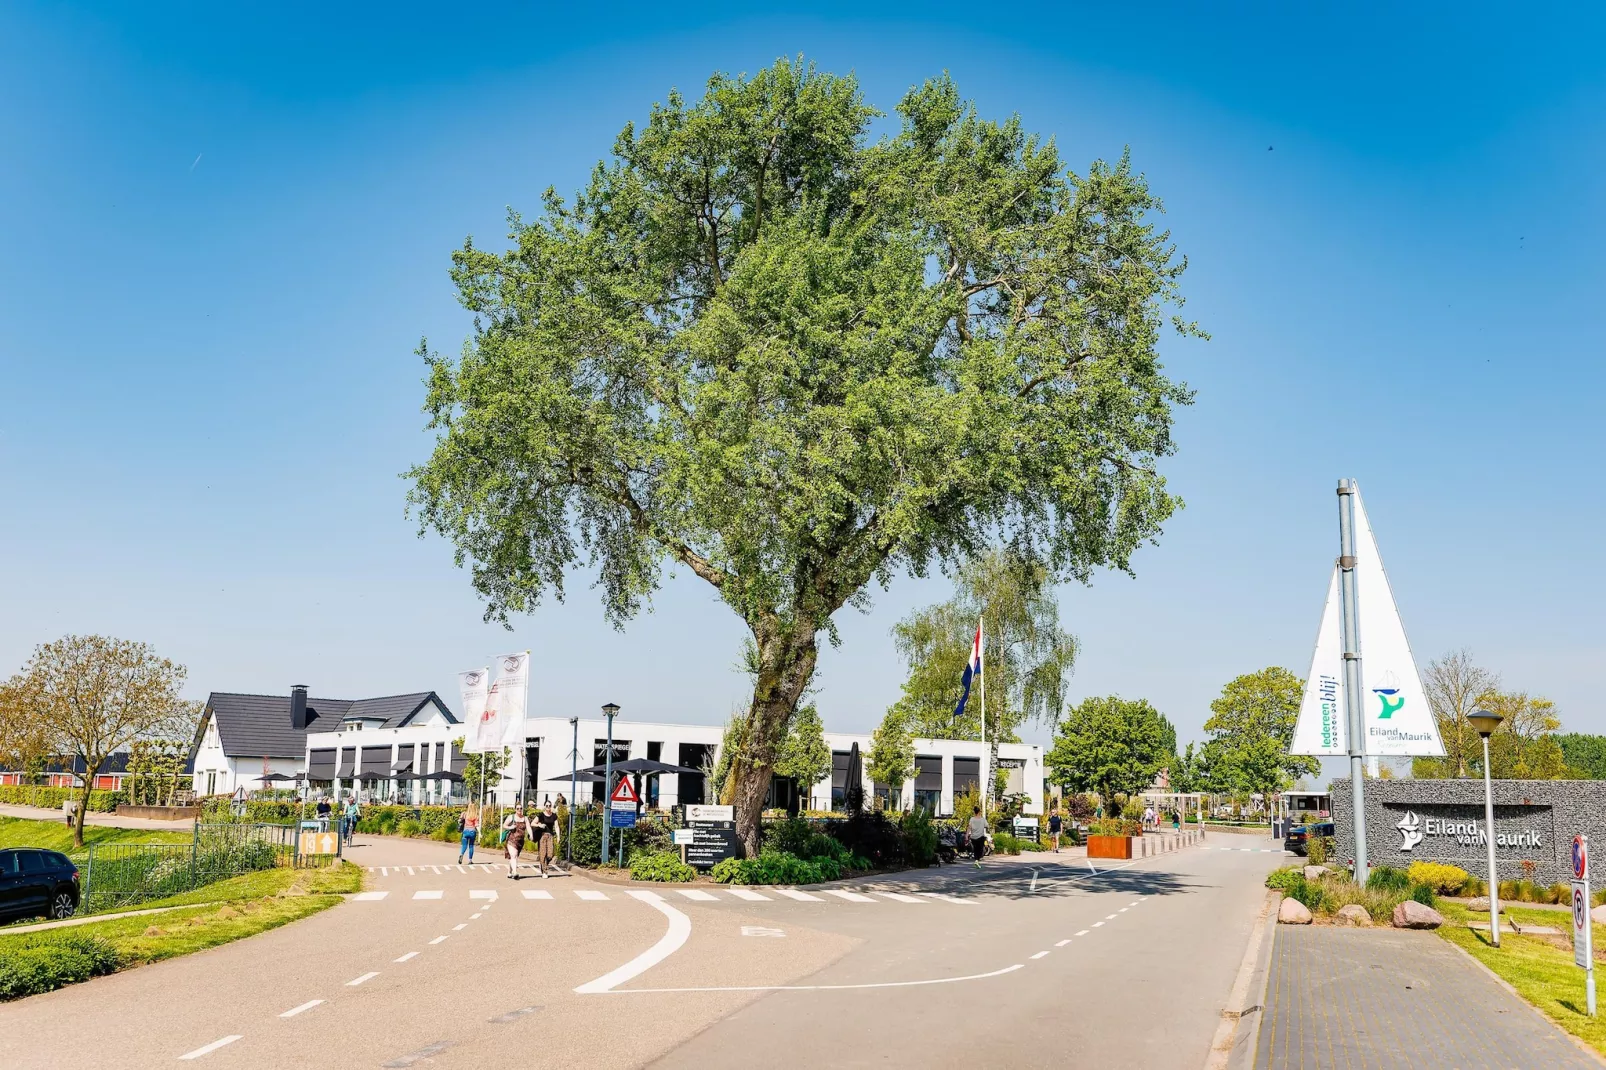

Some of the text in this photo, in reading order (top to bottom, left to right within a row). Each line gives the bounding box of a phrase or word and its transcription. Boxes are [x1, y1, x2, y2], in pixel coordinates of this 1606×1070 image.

[1319, 675, 1340, 748] Iedereen blij!
[1369, 727, 1398, 736] Eiland
[1399, 732, 1432, 741] Maurik
[1425, 819, 1477, 835] Eiland
[1456, 835, 1479, 844] van
